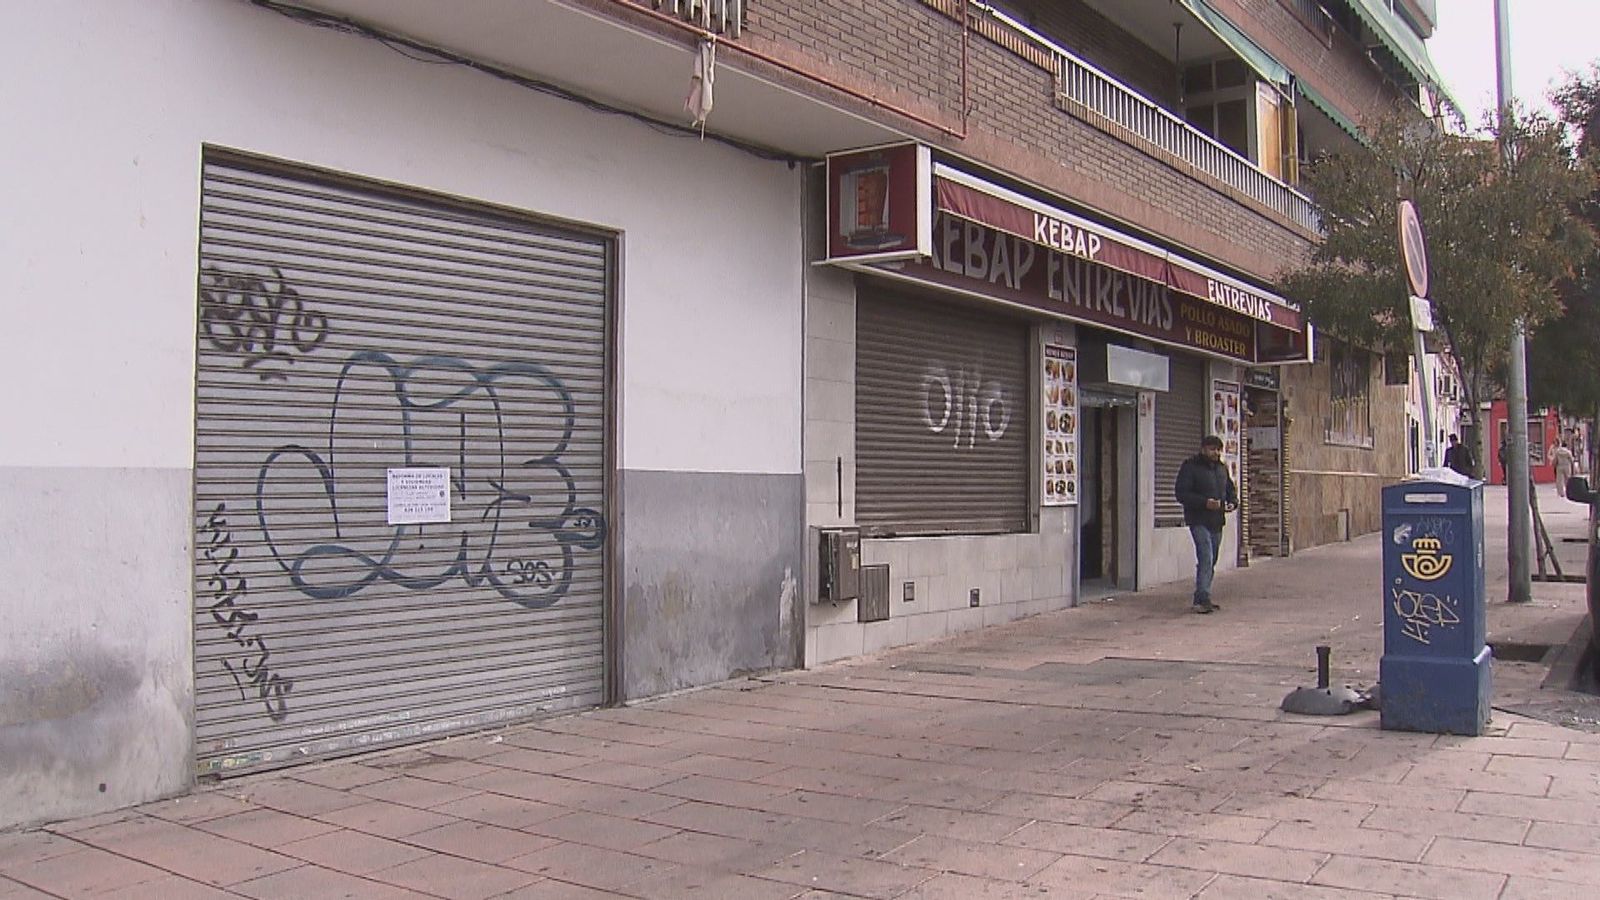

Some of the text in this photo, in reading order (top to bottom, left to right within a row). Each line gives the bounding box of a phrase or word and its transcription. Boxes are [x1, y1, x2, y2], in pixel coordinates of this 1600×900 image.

[1034, 213, 1101, 260] KEBAP
[1048, 249, 1173, 331] ENTREVIAS
[1207, 279, 1272, 322] ENTREVIAS
[1180, 302, 1250, 338] POLLO ASADO
[1184, 326, 1247, 356] Y BROASTER
